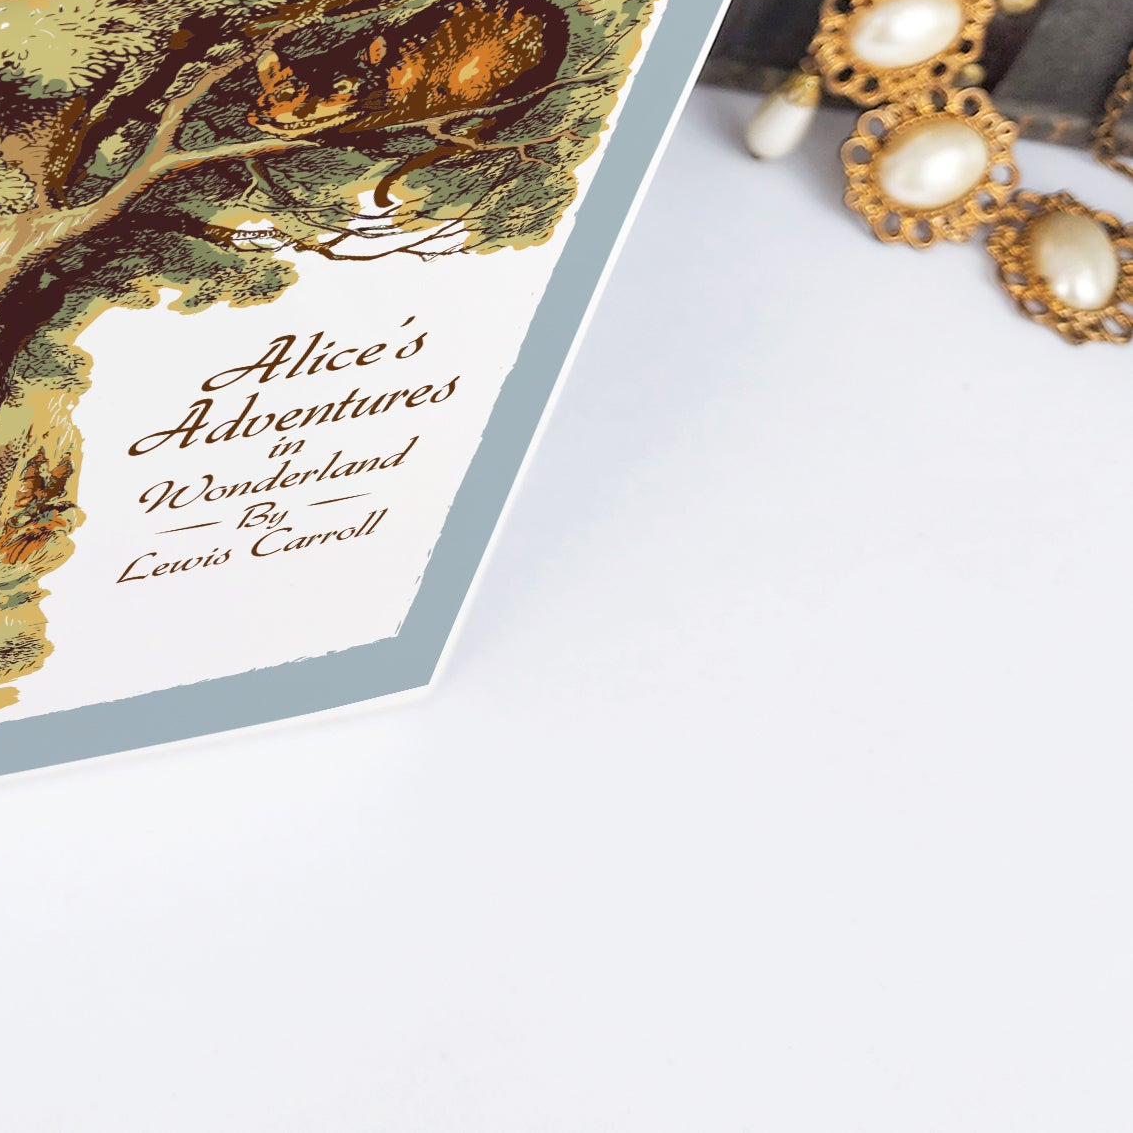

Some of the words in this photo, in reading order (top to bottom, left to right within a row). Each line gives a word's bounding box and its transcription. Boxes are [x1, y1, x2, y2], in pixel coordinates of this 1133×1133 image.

[201, 315, 428, 393] Alice's
[128, 375, 461, 457] Adventures
[267, 435, 306, 459] in
[138, 435, 420, 514] Wonderland
[116, 547, 232, 584] Lewis
[250, 507, 389, 558] Carroll
[236, 501, 289, 530] By
